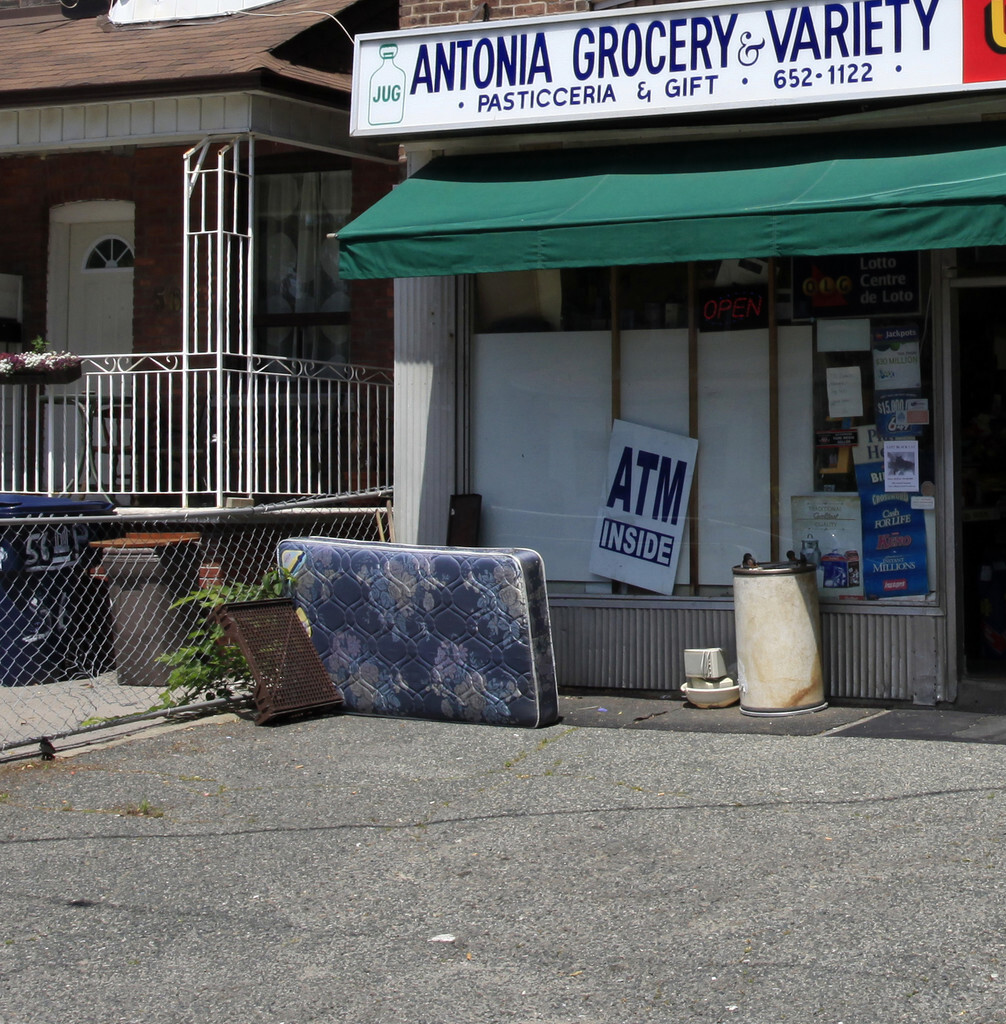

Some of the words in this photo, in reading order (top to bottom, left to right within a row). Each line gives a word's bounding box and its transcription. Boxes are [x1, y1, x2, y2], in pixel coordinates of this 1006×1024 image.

[409, 32, 554, 95] ANTONIA
[573, 12, 739, 81] GROCERY
[738, 31, 766, 67] &
[371, 84, 401, 104] JUG
[477, 83, 617, 114] PASTICCERIA
[637, 81, 652, 102] &
[665, 76, 719, 99] GIFT
[860, 257, 896, 270] Lotto
[860, 273, 906, 287] Centre
[860, 291, 877, 304] de
[882, 290, 913, 303] Loto
[703, 297, 763, 320] OPEN
[888, 356, 918, 365] MILLION
[606, 446, 687, 525] ATM
[874, 518, 892, 529] FOR
[891, 514, 912, 527] LIFE
[601, 520, 674, 565] INSIDE
[873, 562, 916, 574] MILLIONS
